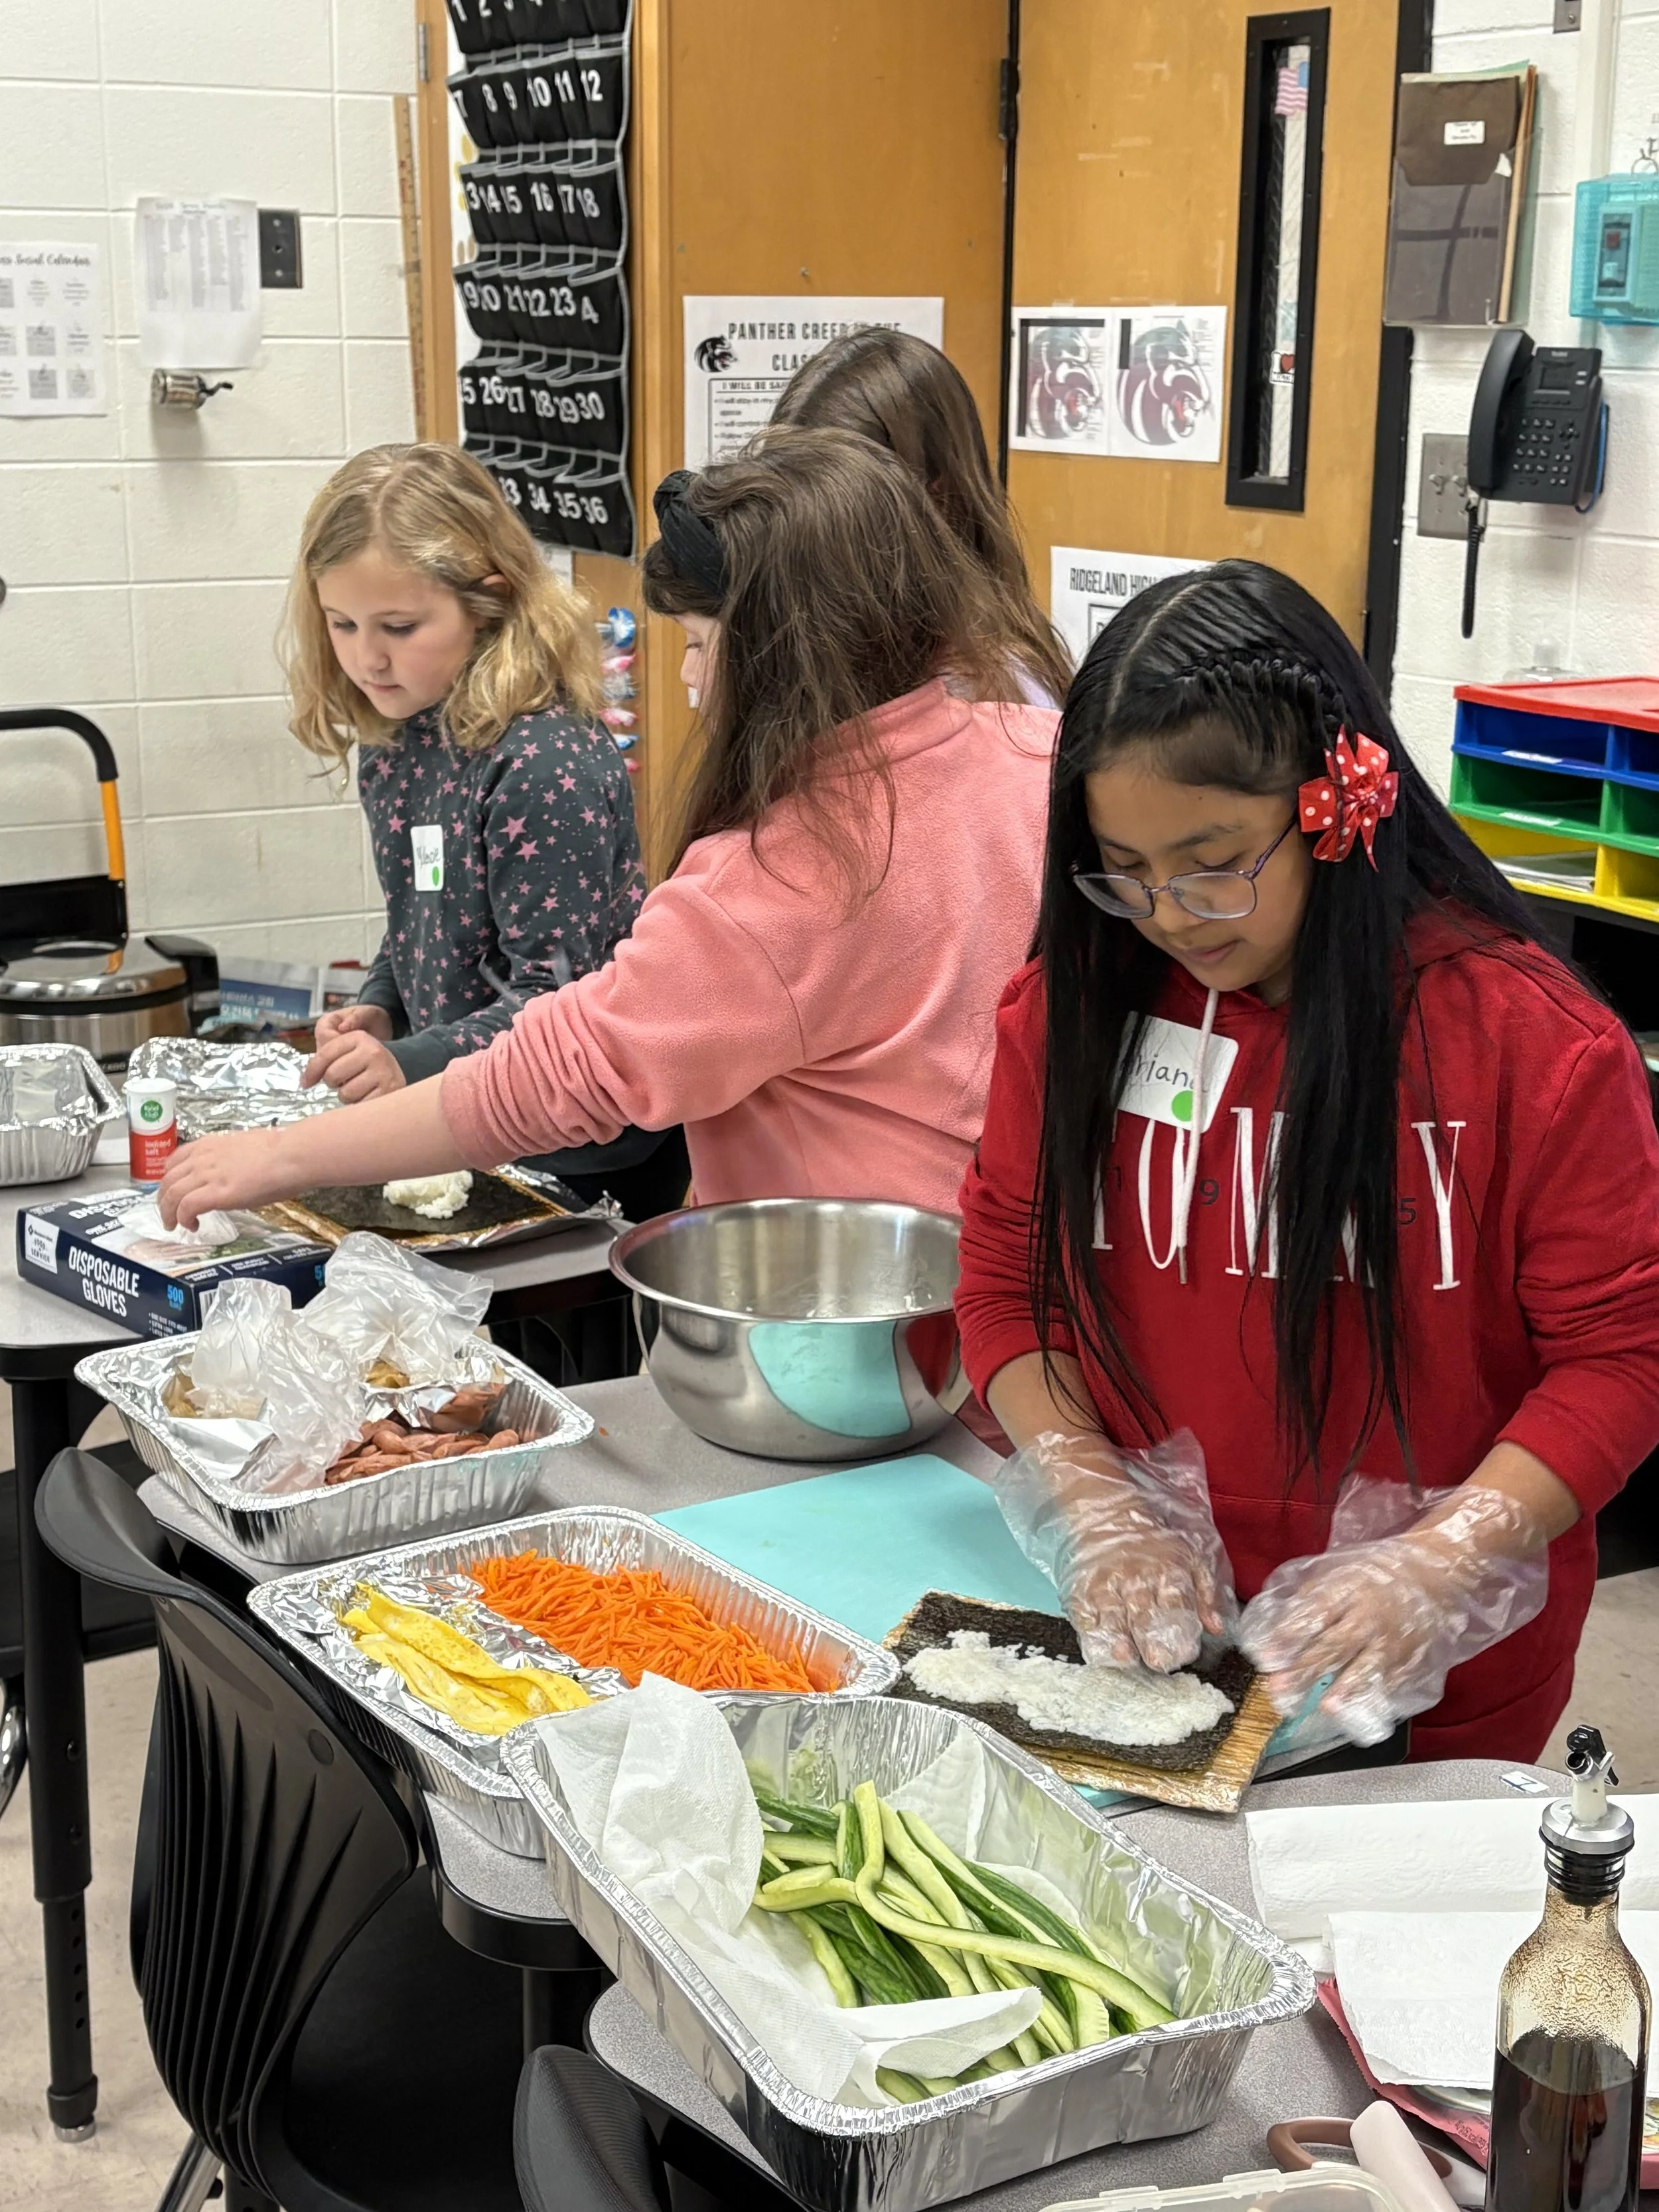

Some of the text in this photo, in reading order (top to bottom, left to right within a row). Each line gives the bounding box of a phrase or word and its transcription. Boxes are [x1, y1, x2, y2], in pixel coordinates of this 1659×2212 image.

[482, 83, 498, 113] 8
[503, 81, 518, 110] 9
[528, 76, 552, 108] 10
[555, 70, 575, 102] 11
[581, 69, 603, 102] 12
[530, 181, 554, 212] 16
[576, 187, 601, 218] 18
[549, 286, 577, 317] 23
[581, 295, 600, 324] 4
[728, 323, 796, 339] PANTHER
[479, 375, 506, 405] 26
[575, 391, 605, 420] 30
[579, 496, 609, 524] 36
[1070, 567, 1127, 597] RIDGELAND
[1198, 1179, 1220, 1206] 9
[1398, 1197, 1417, 1225] 5
[68, 1245, 140, 1298] DISPOSABLE
[82, 1277, 127, 1317] GLOVES
[167, 1284, 184, 1306] 500
